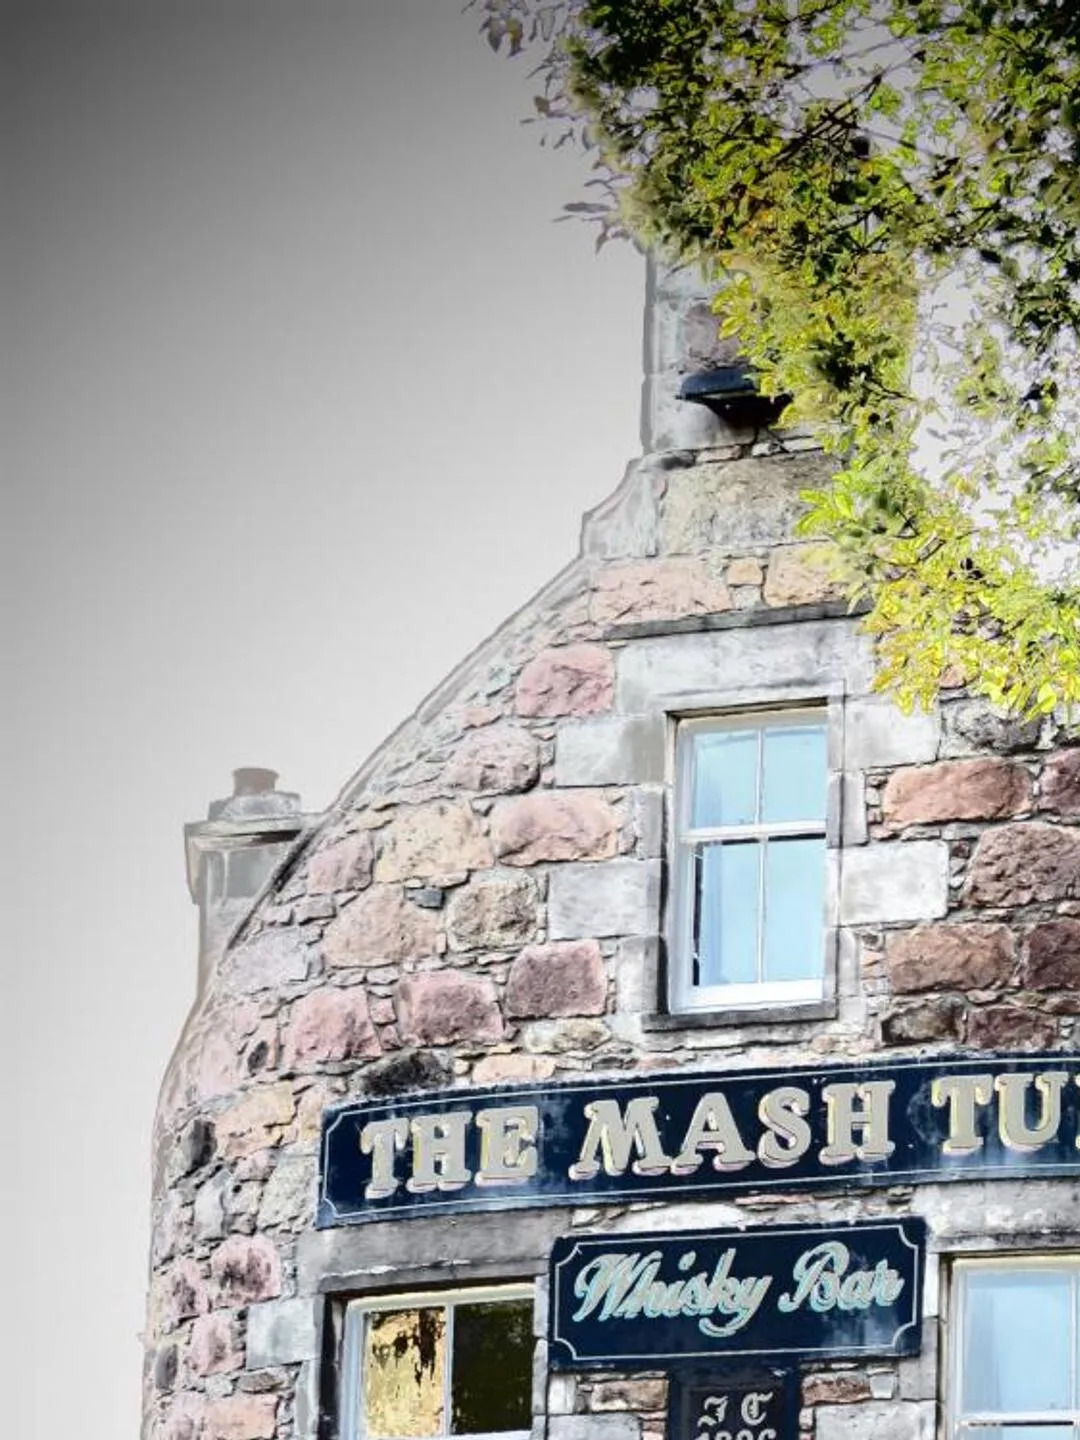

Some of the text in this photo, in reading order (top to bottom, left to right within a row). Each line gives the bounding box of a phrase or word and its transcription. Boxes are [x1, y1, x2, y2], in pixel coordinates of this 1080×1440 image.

[360, 1105, 539, 1199] THE
[568, 1080, 896, 1180] MASH
[572, 1240, 905, 1338] Whisky Bar
